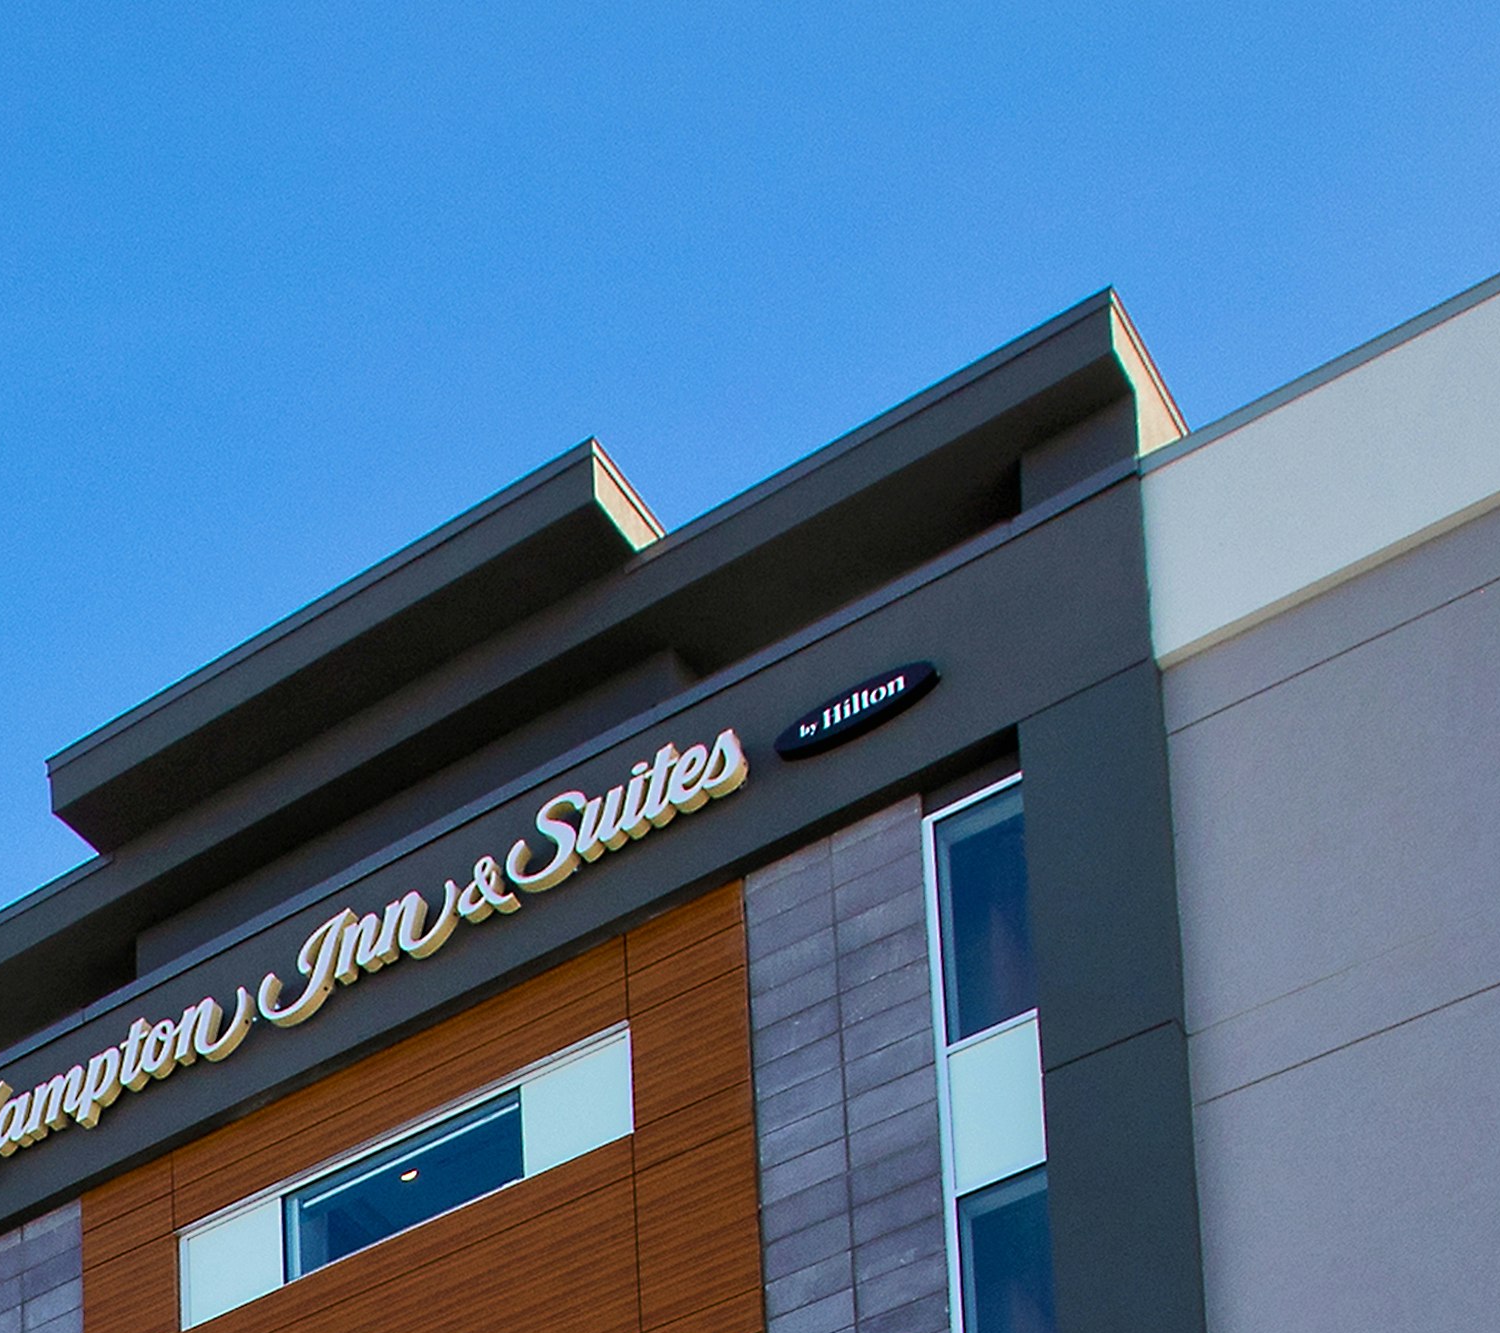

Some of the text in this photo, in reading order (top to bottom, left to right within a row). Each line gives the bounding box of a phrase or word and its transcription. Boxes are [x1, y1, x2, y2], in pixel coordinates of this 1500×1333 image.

[799, 675, 905, 738] by Hilton
[257, 879, 460, 1027] Inn
[457, 855, 521, 923] &
[506, 728, 748, 893] Suites
